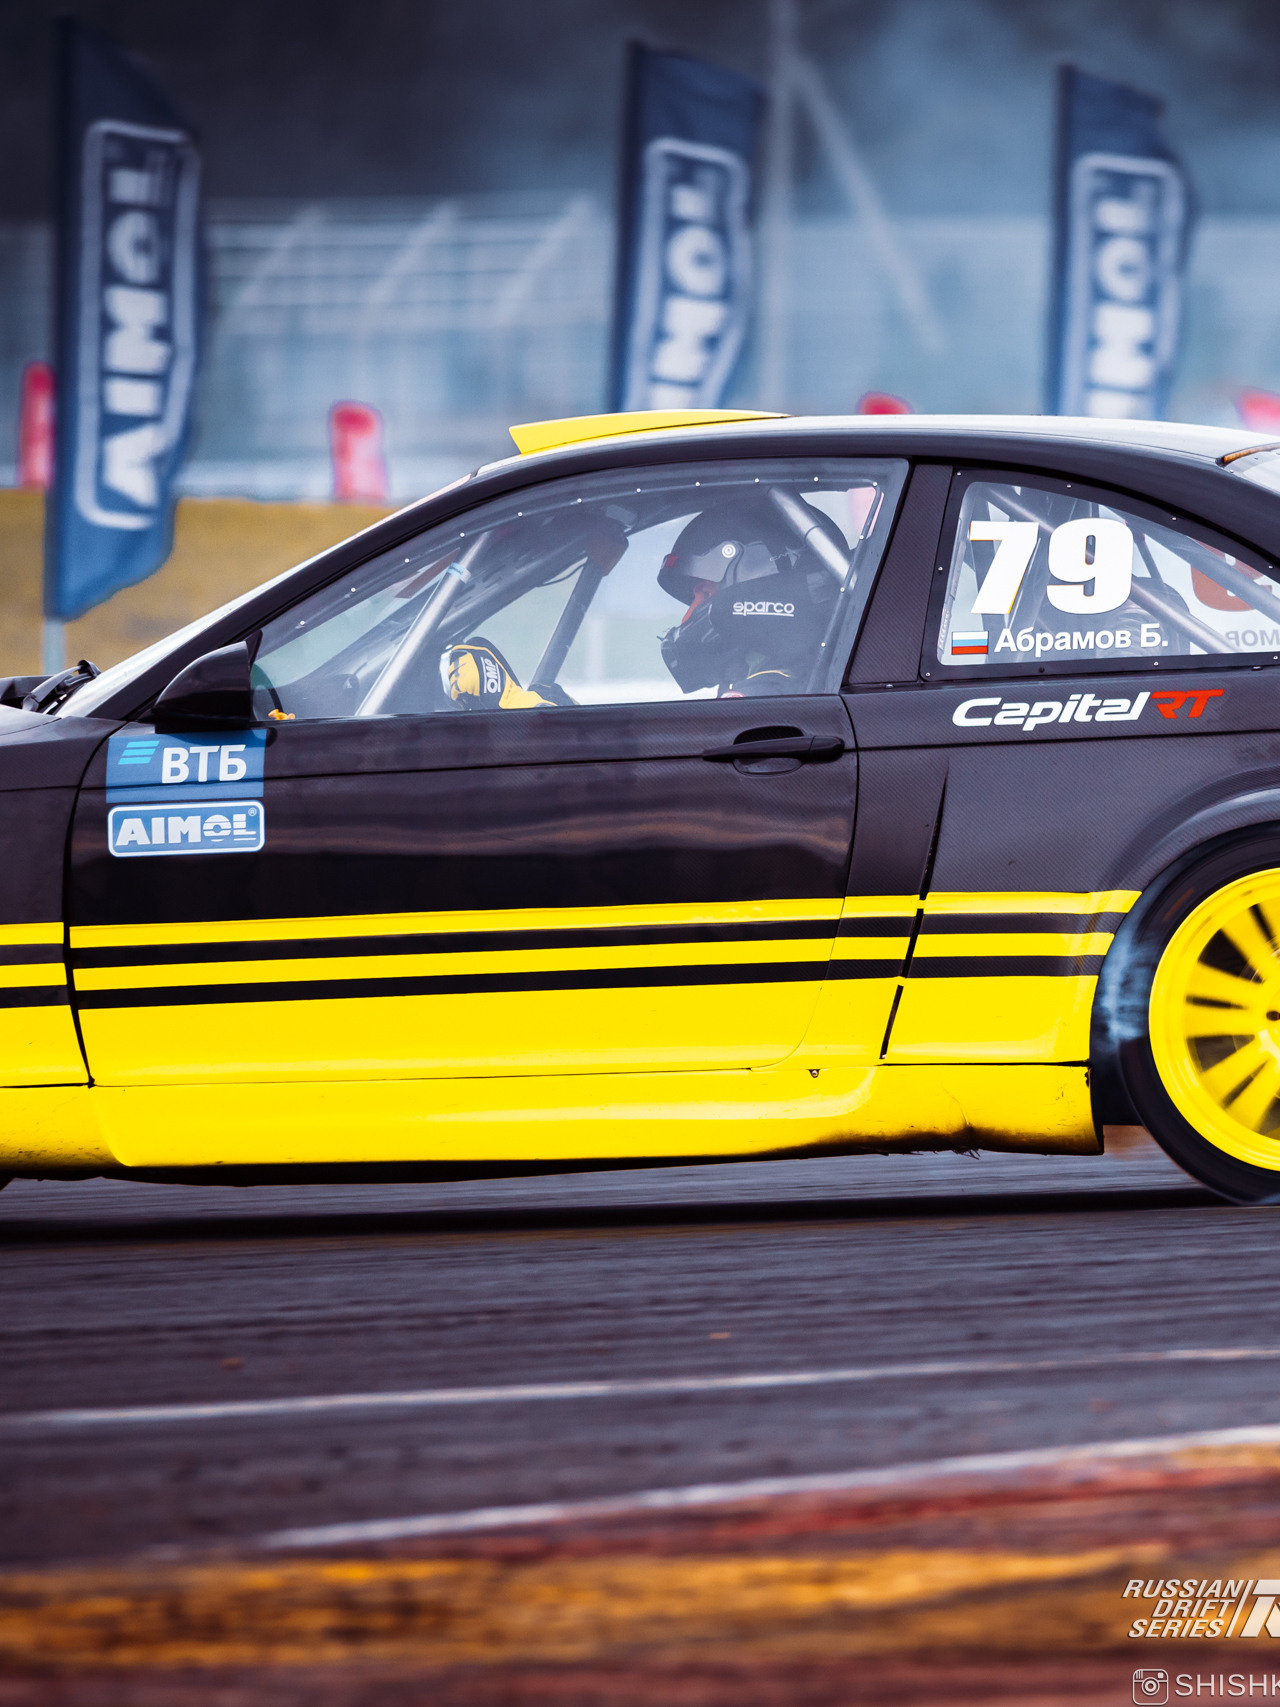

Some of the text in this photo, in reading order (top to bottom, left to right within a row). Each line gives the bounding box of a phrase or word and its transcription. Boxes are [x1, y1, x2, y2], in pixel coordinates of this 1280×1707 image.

[652, 168, 725, 409] IMOL
[1088, 180, 1152, 416] IMOL
[969, 517, 1134, 615] 79
[732, 601, 795, 617] sparco
[994, 623, 1169, 658] Абрамов Б.
[484, 658, 498, 693] OMP
[161, 744, 247, 784] ВТБ
